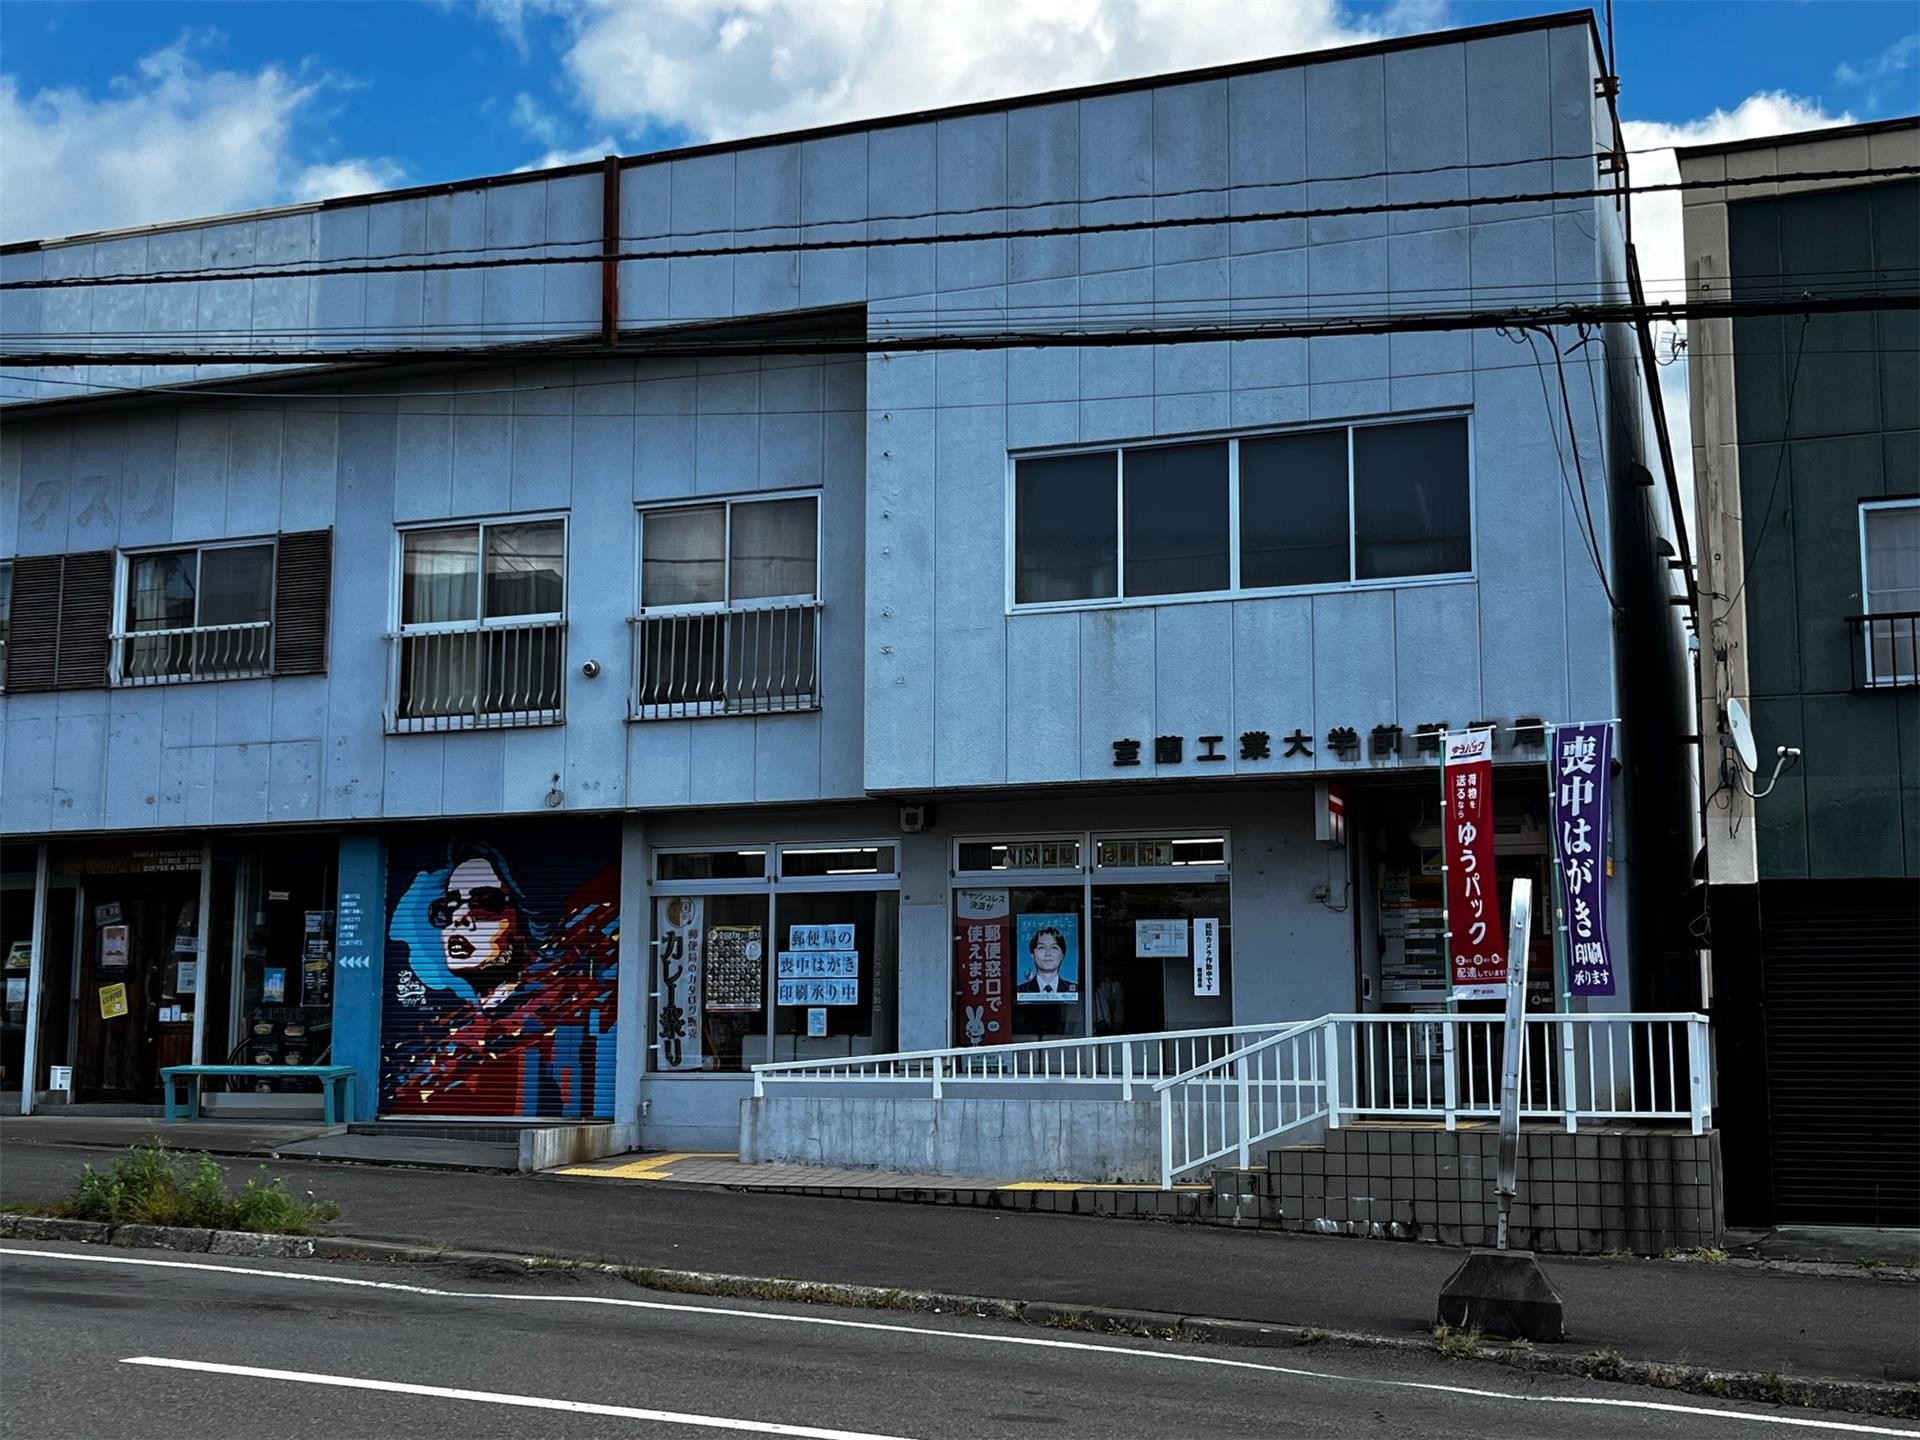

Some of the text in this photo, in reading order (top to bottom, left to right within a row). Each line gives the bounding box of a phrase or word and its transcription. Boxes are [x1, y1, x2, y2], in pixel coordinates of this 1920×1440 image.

[1452, 740, 1485, 755] ゆうパック
[1456, 774, 1467, 819] 送るなら
[1467, 773, 1478, 809] 荷物を
[1560, 736, 1597, 939] 喪中はがき
[960, 890, 1005, 903] キャッシュレス
[1457, 821, 1486, 945] ゆうパック
[791, 930, 852, 947] 郵便局の
[781, 956, 856, 974] 喪中はがき
[967, 924, 984, 995] 使えます
[984, 924, 1002, 1012] 郵便窓口で
[1574, 942, 1605, 966] 印刷
[779, 983, 856, 1001] 印刷承り中
[1573, 969, 1610, 986] 承ります
[659, 931, 687, 1066] カレー祭り
